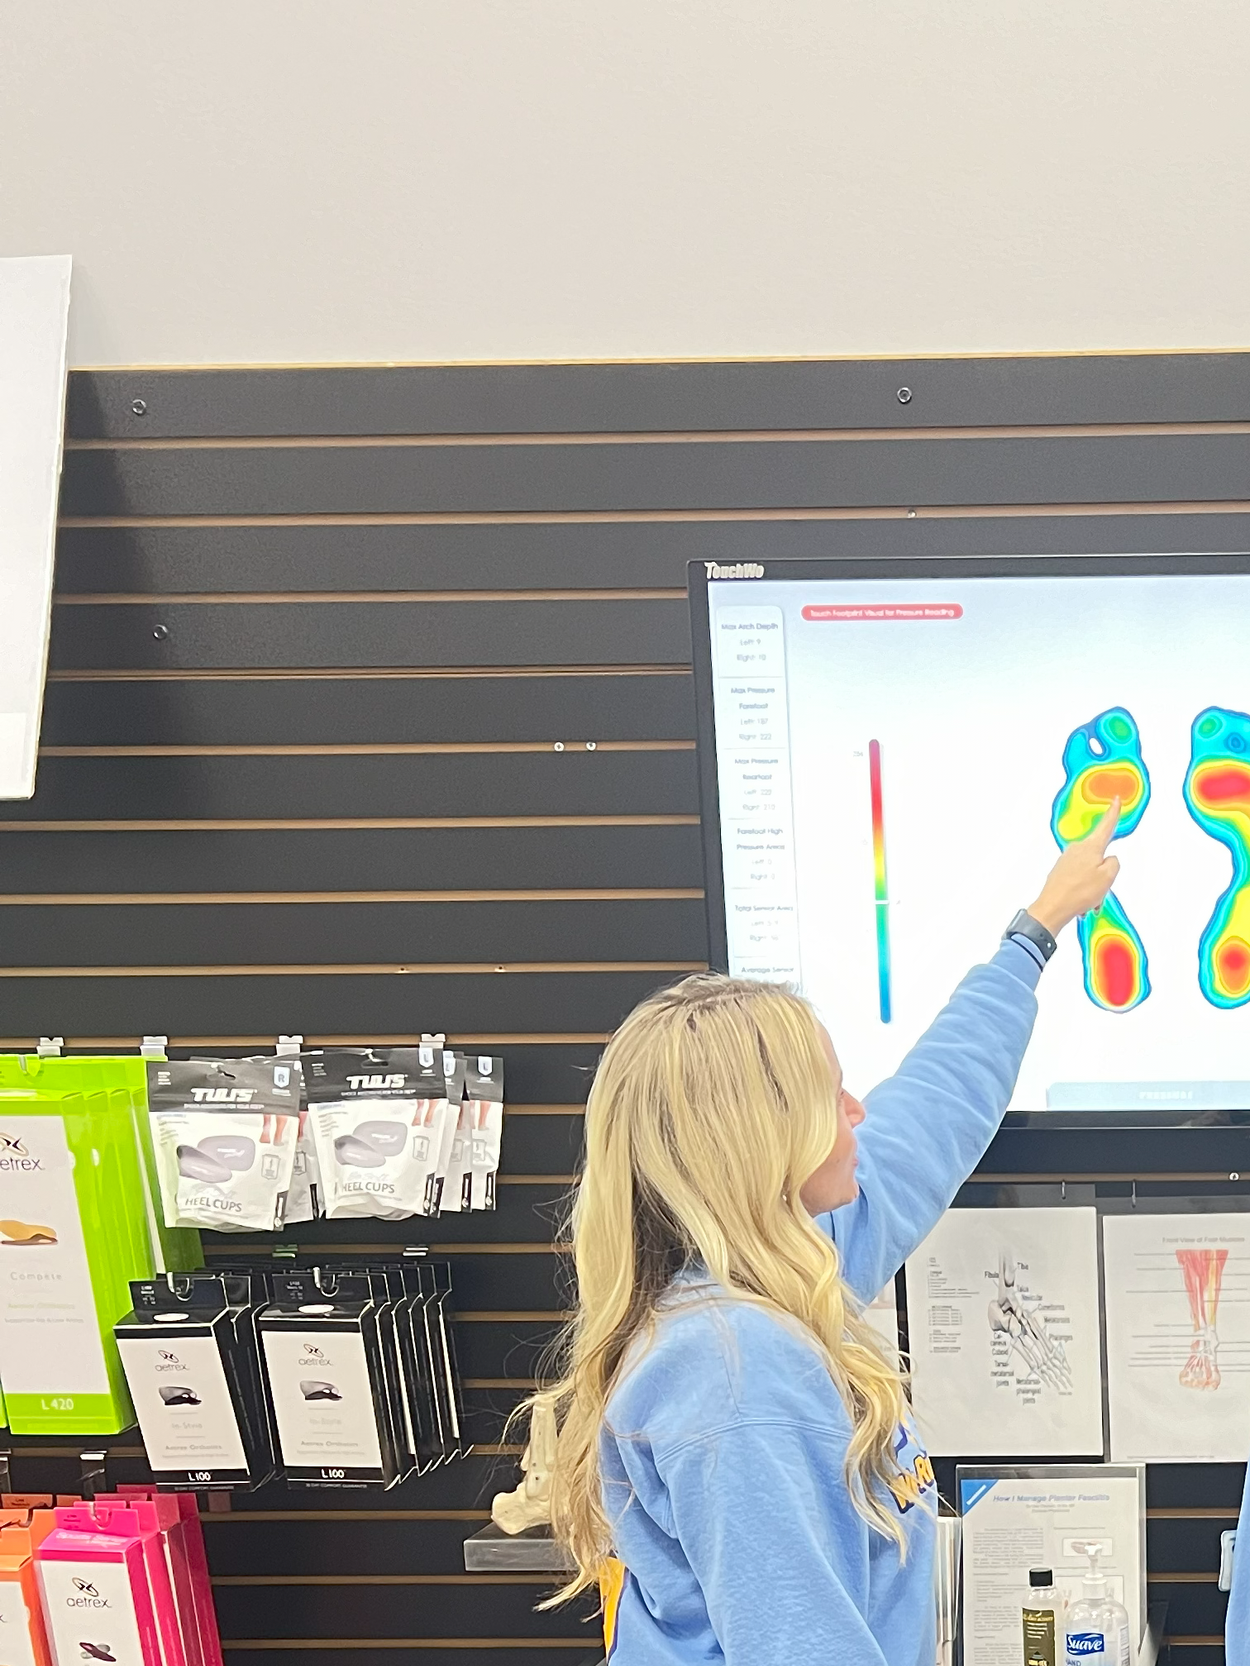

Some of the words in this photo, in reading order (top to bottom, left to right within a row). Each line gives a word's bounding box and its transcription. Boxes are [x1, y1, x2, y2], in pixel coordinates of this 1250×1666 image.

[925, 608, 954, 617] Reading
[738, 622, 755, 630] Arch
[756, 622, 779, 632] Depth
[0, 1158, 42, 1171] etrex
[365, 1182, 395, 1194] CUPS
[185, 1197, 211, 1207] HEEL
[213, 1198, 243, 1212] CUPS
[298, 1358, 331, 1366] aetrex
[155, 1363, 186, 1372] aetrex
[1016, 1495, 1046, 1503] Manage
[67, 1597, 111, 1608] aetrex
[1068, 1636, 1102, 1650] Suave
